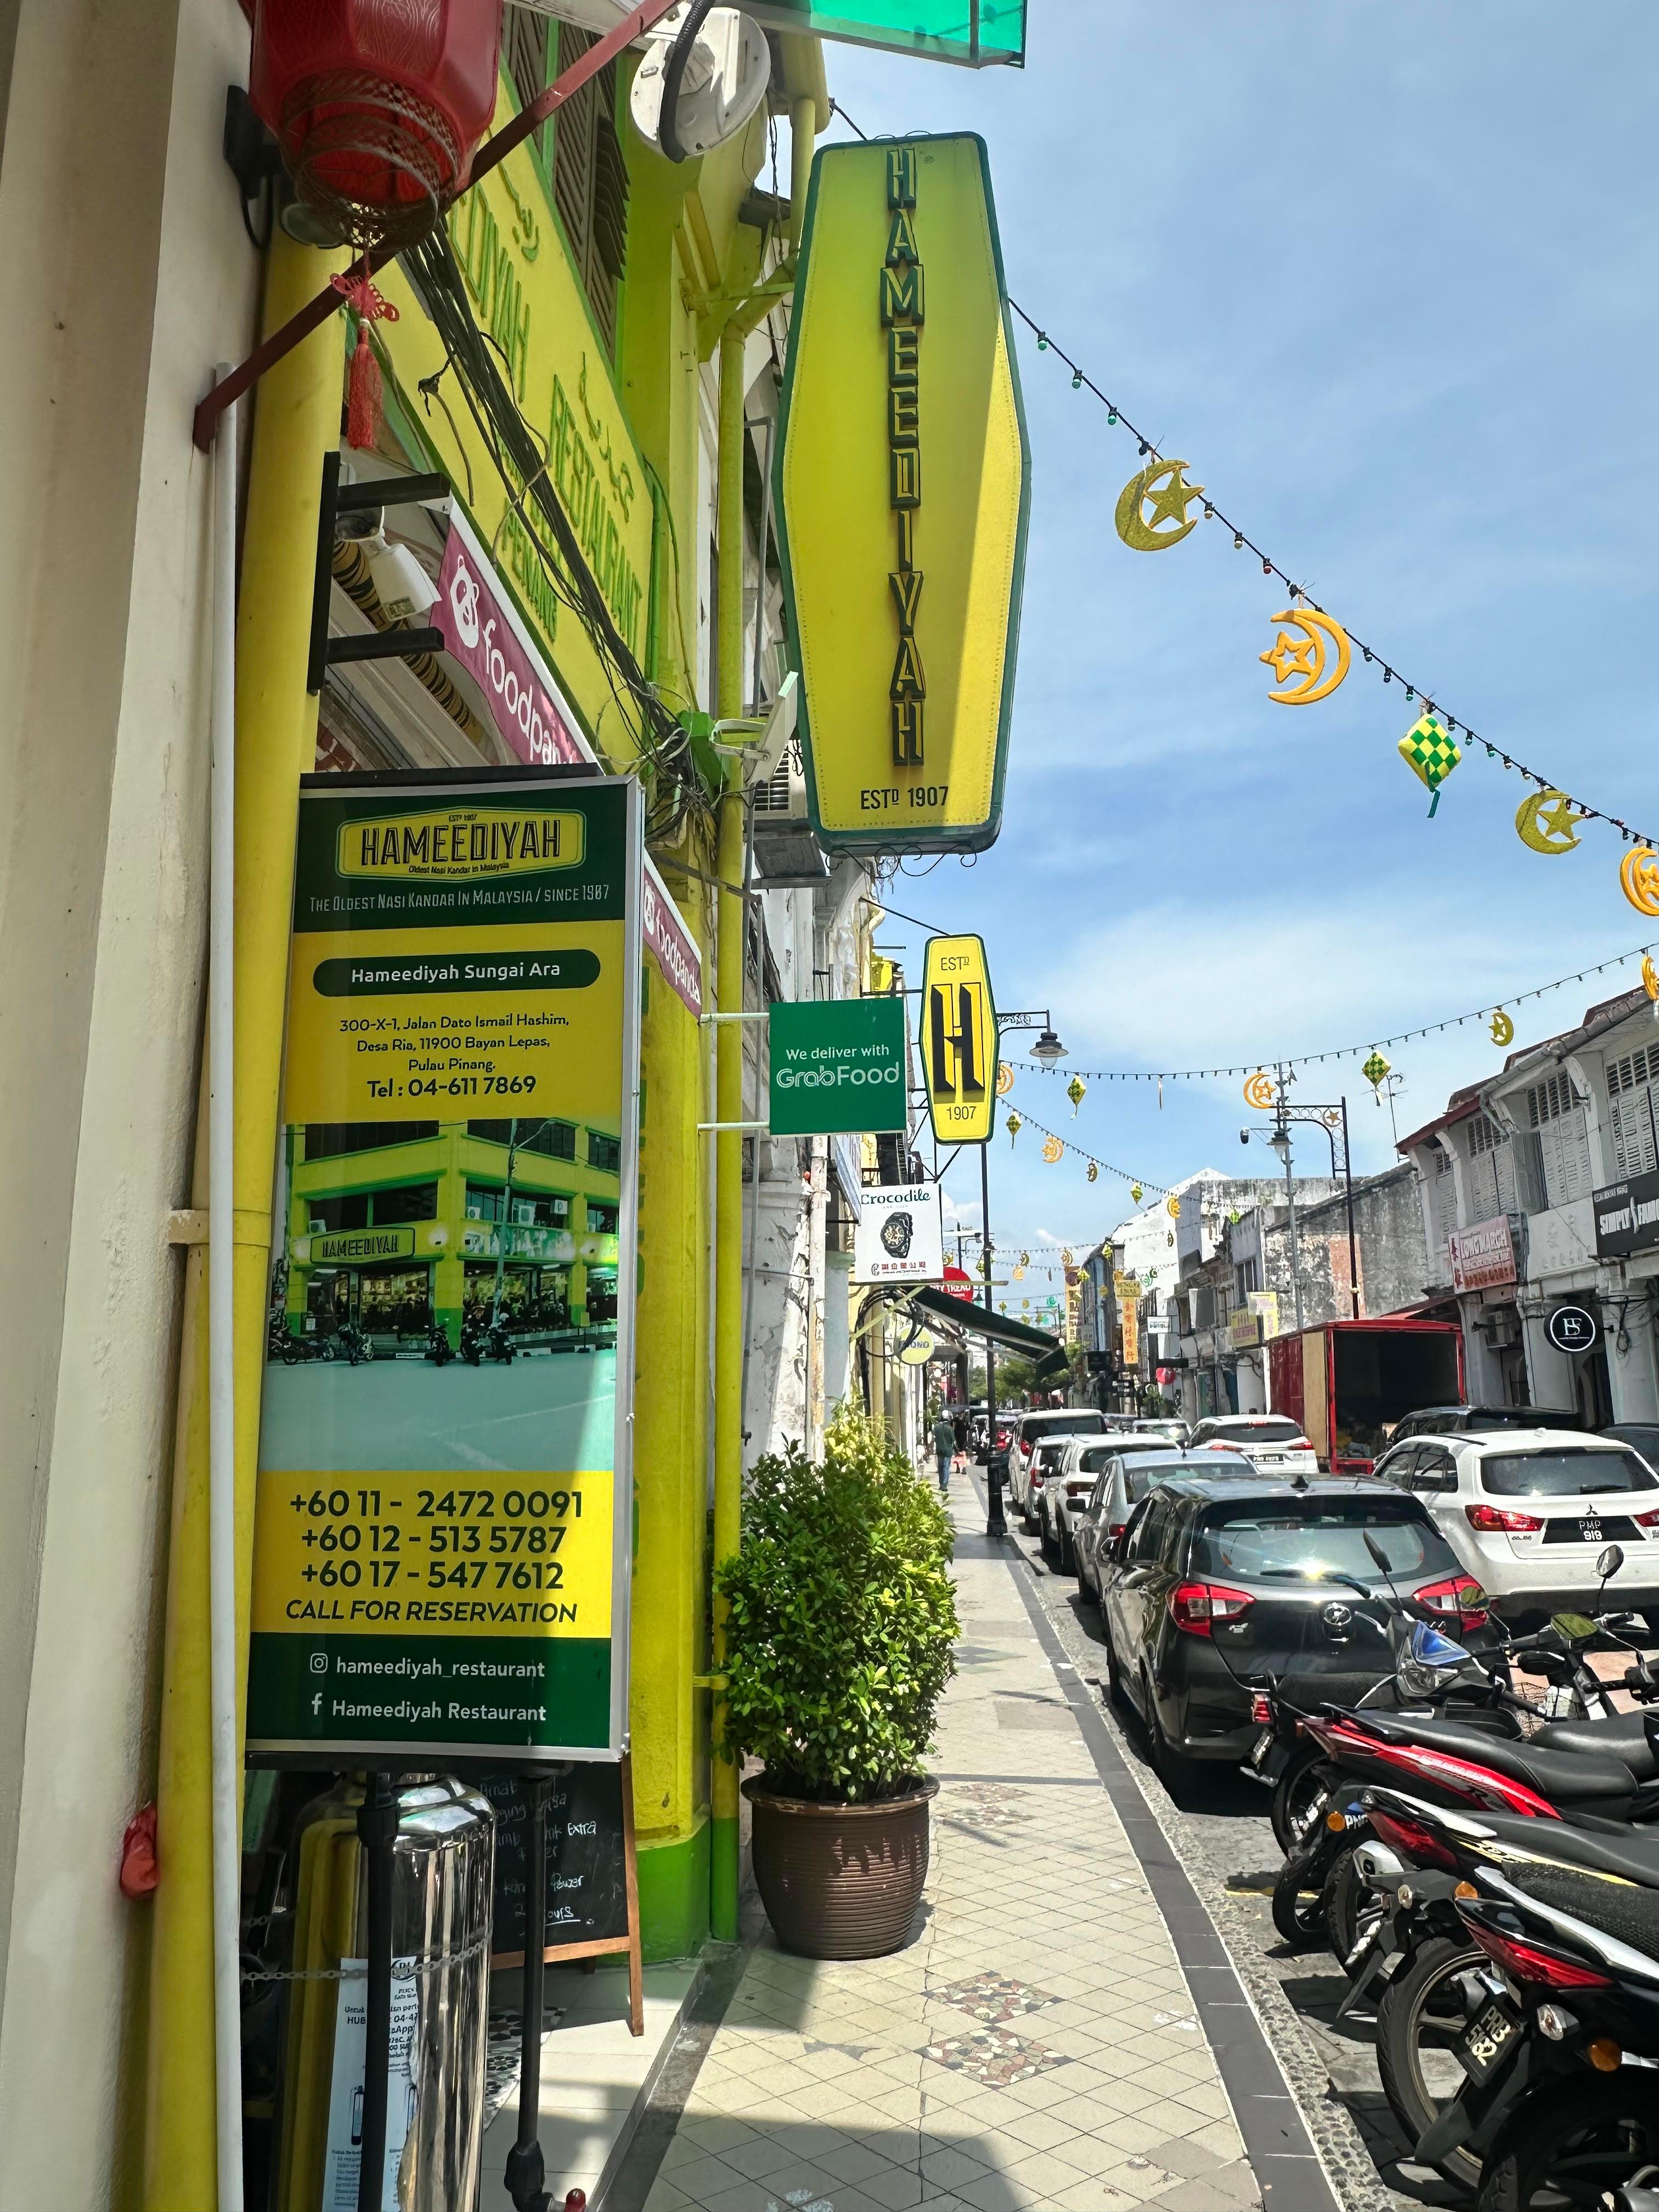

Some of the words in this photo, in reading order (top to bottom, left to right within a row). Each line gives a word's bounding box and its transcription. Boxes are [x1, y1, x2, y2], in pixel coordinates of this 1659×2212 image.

[881, 147, 925, 766] HAMEEDIYAH
[549, 374, 642, 660] RESTAURANT
[483, 618, 574, 765] foodpan
[907, 786, 949, 807] 1907
[362, 820, 560, 865] HAMEEDIYAH
[352, 964, 459, 983] Hameediyah
[465, 962, 523, 980] Sungai
[529, 963, 560, 976] Ara
[340, 1018, 400, 1032] 300-X-1,
[403, 1016, 436, 1029] Jalan
[441, 1016, 471, 1029] Dato
[476, 1013, 513, 1027] Ismail
[517, 1012, 569, 1026] Hashim,
[357, 1040, 388, 1052] Desa
[392, 1039, 416, 1051] Ria,
[420, 1037, 461, 1049] 11900
[465, 1036, 505, 1051] Bayan
[509, 1035, 550, 1049] Lepas,
[786, 1049, 807, 1060] We
[811, 1047, 858, 1060] deliver
[861, 1044, 890, 1057] with
[409, 1058, 444, 1071] Pulau
[449, 1058, 496, 1073] Pinang.
[776, 1062, 900, 1088] GrabFood
[366, 1078, 393, 1097] Tel
[408, 1077, 477, 1096] 04-611
[483, 1075, 536, 1094] 7869
[946, 1105, 977, 1121] 1907
[861, 1188, 931, 1205] Crocodile
[290, 1490, 349, 1517] +60
[358, 1491, 381, 1517] 11
[416, 1491, 494, 1517] 2472
[503, 1491, 582, 1518] 0091
[302, 1525, 361, 1552] +60
[370, 1526, 400, 1552] 12
[429, 1526, 481, 1553] 513
[489, 1526, 567, 1553] 5787
[302, 1560, 362, 1587] +60
[370, 1561, 400, 1587] 17
[427, 1561, 488, 1589] 547
[495, 1562, 564, 1589] 7612
[286, 1600, 345, 1620] CALL
[350, 1601, 399, 1621] FOR
[405, 1601, 578, 1623] RESERVATION
[332, 1700, 441, 1722] Hameediyah
[448, 1703, 547, 1721] Restaurant
